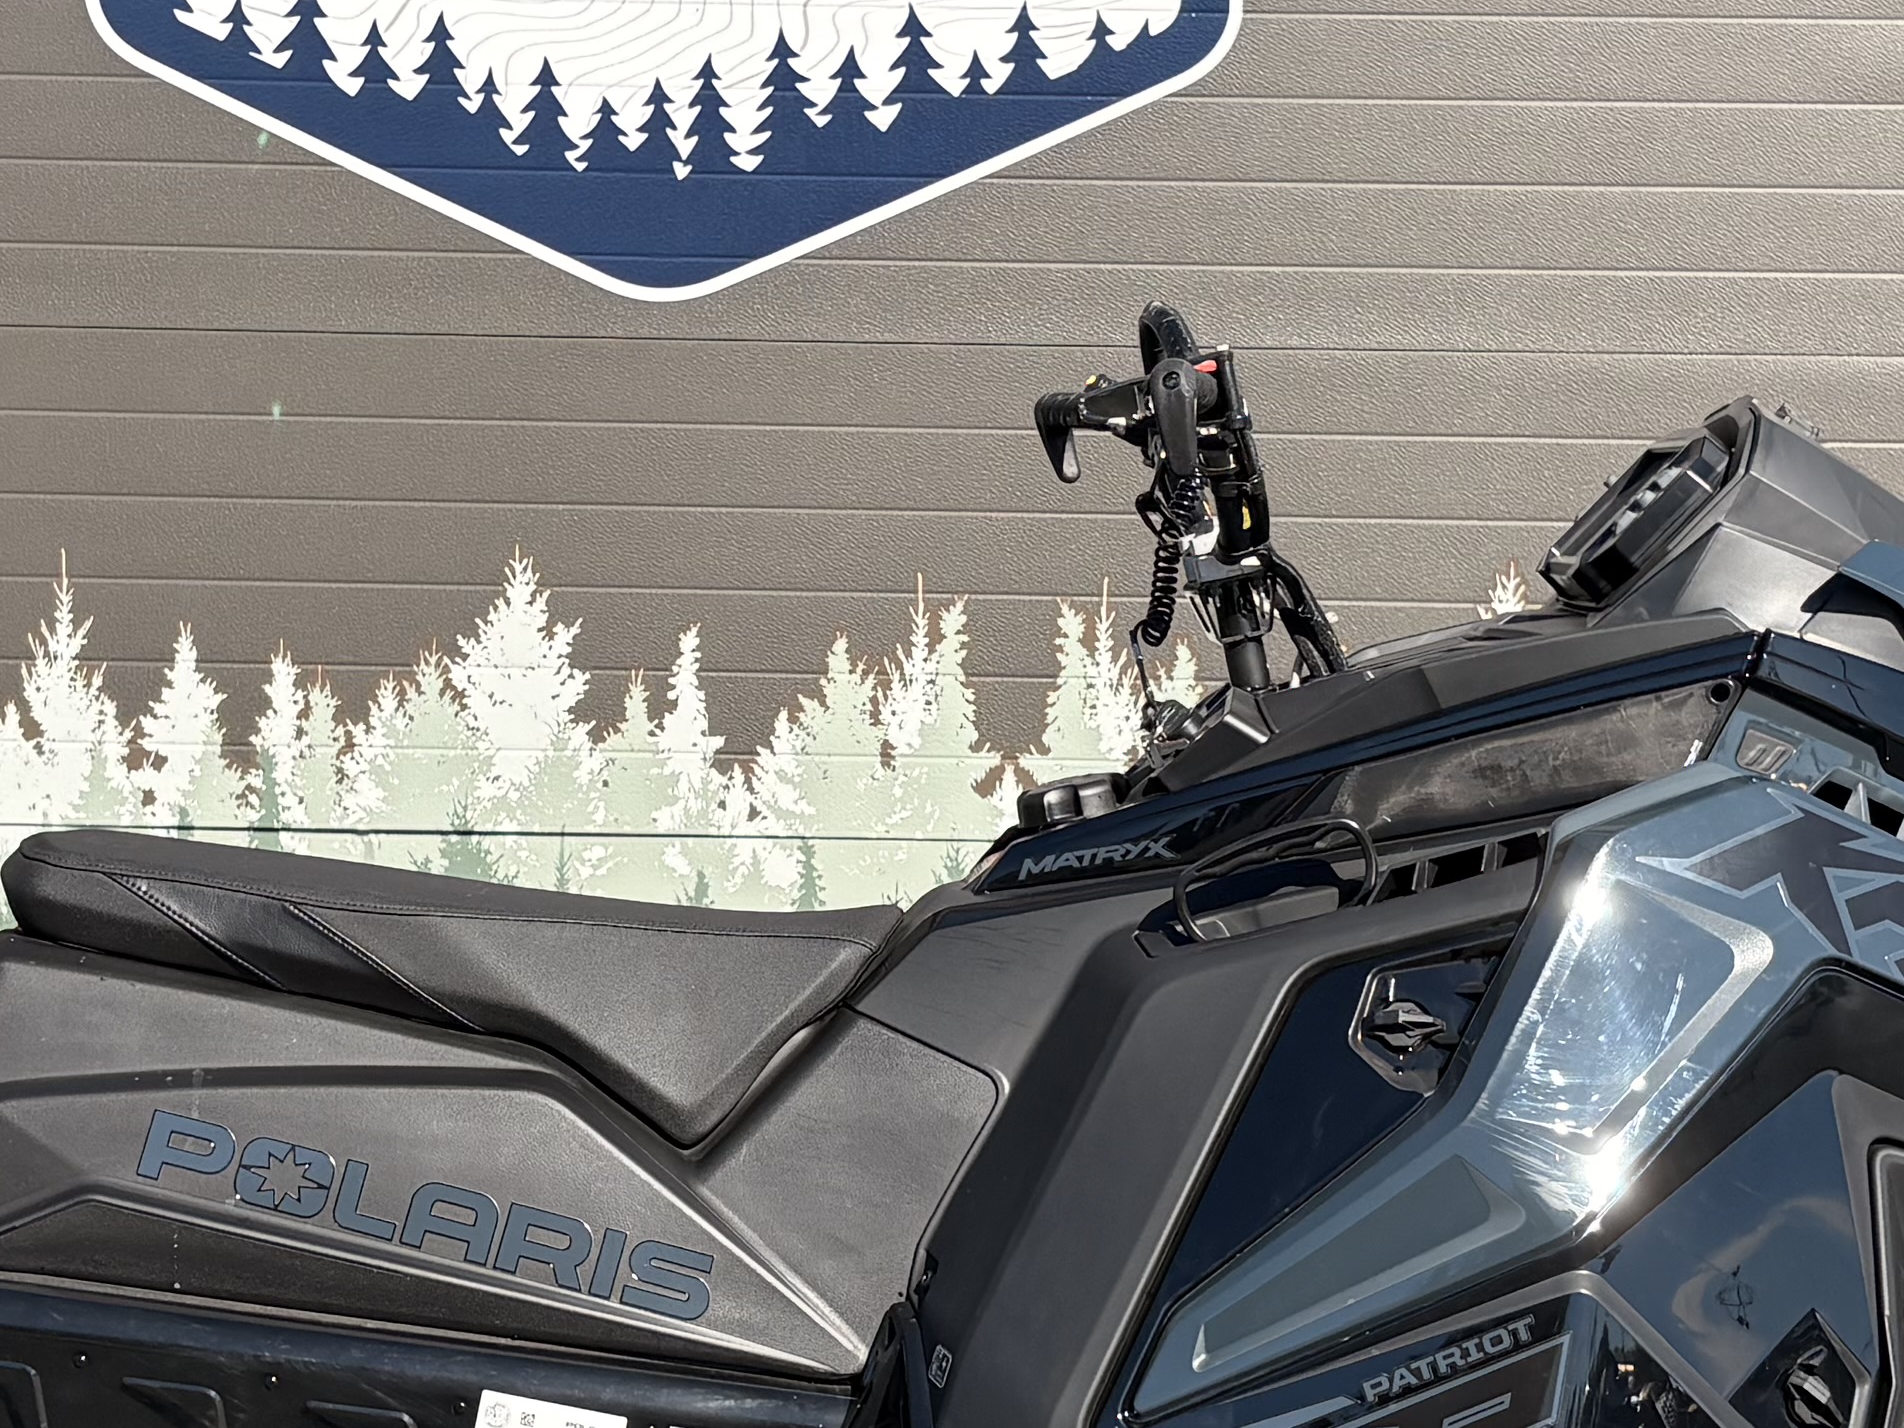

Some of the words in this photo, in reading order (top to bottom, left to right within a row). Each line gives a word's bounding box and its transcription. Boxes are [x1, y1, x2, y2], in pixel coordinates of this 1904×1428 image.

[1017, 834, 1180, 881] MATRYX
[136, 1108, 715, 1321] POLARIS
[1362, 1314, 1535, 1403] PATRIOT
